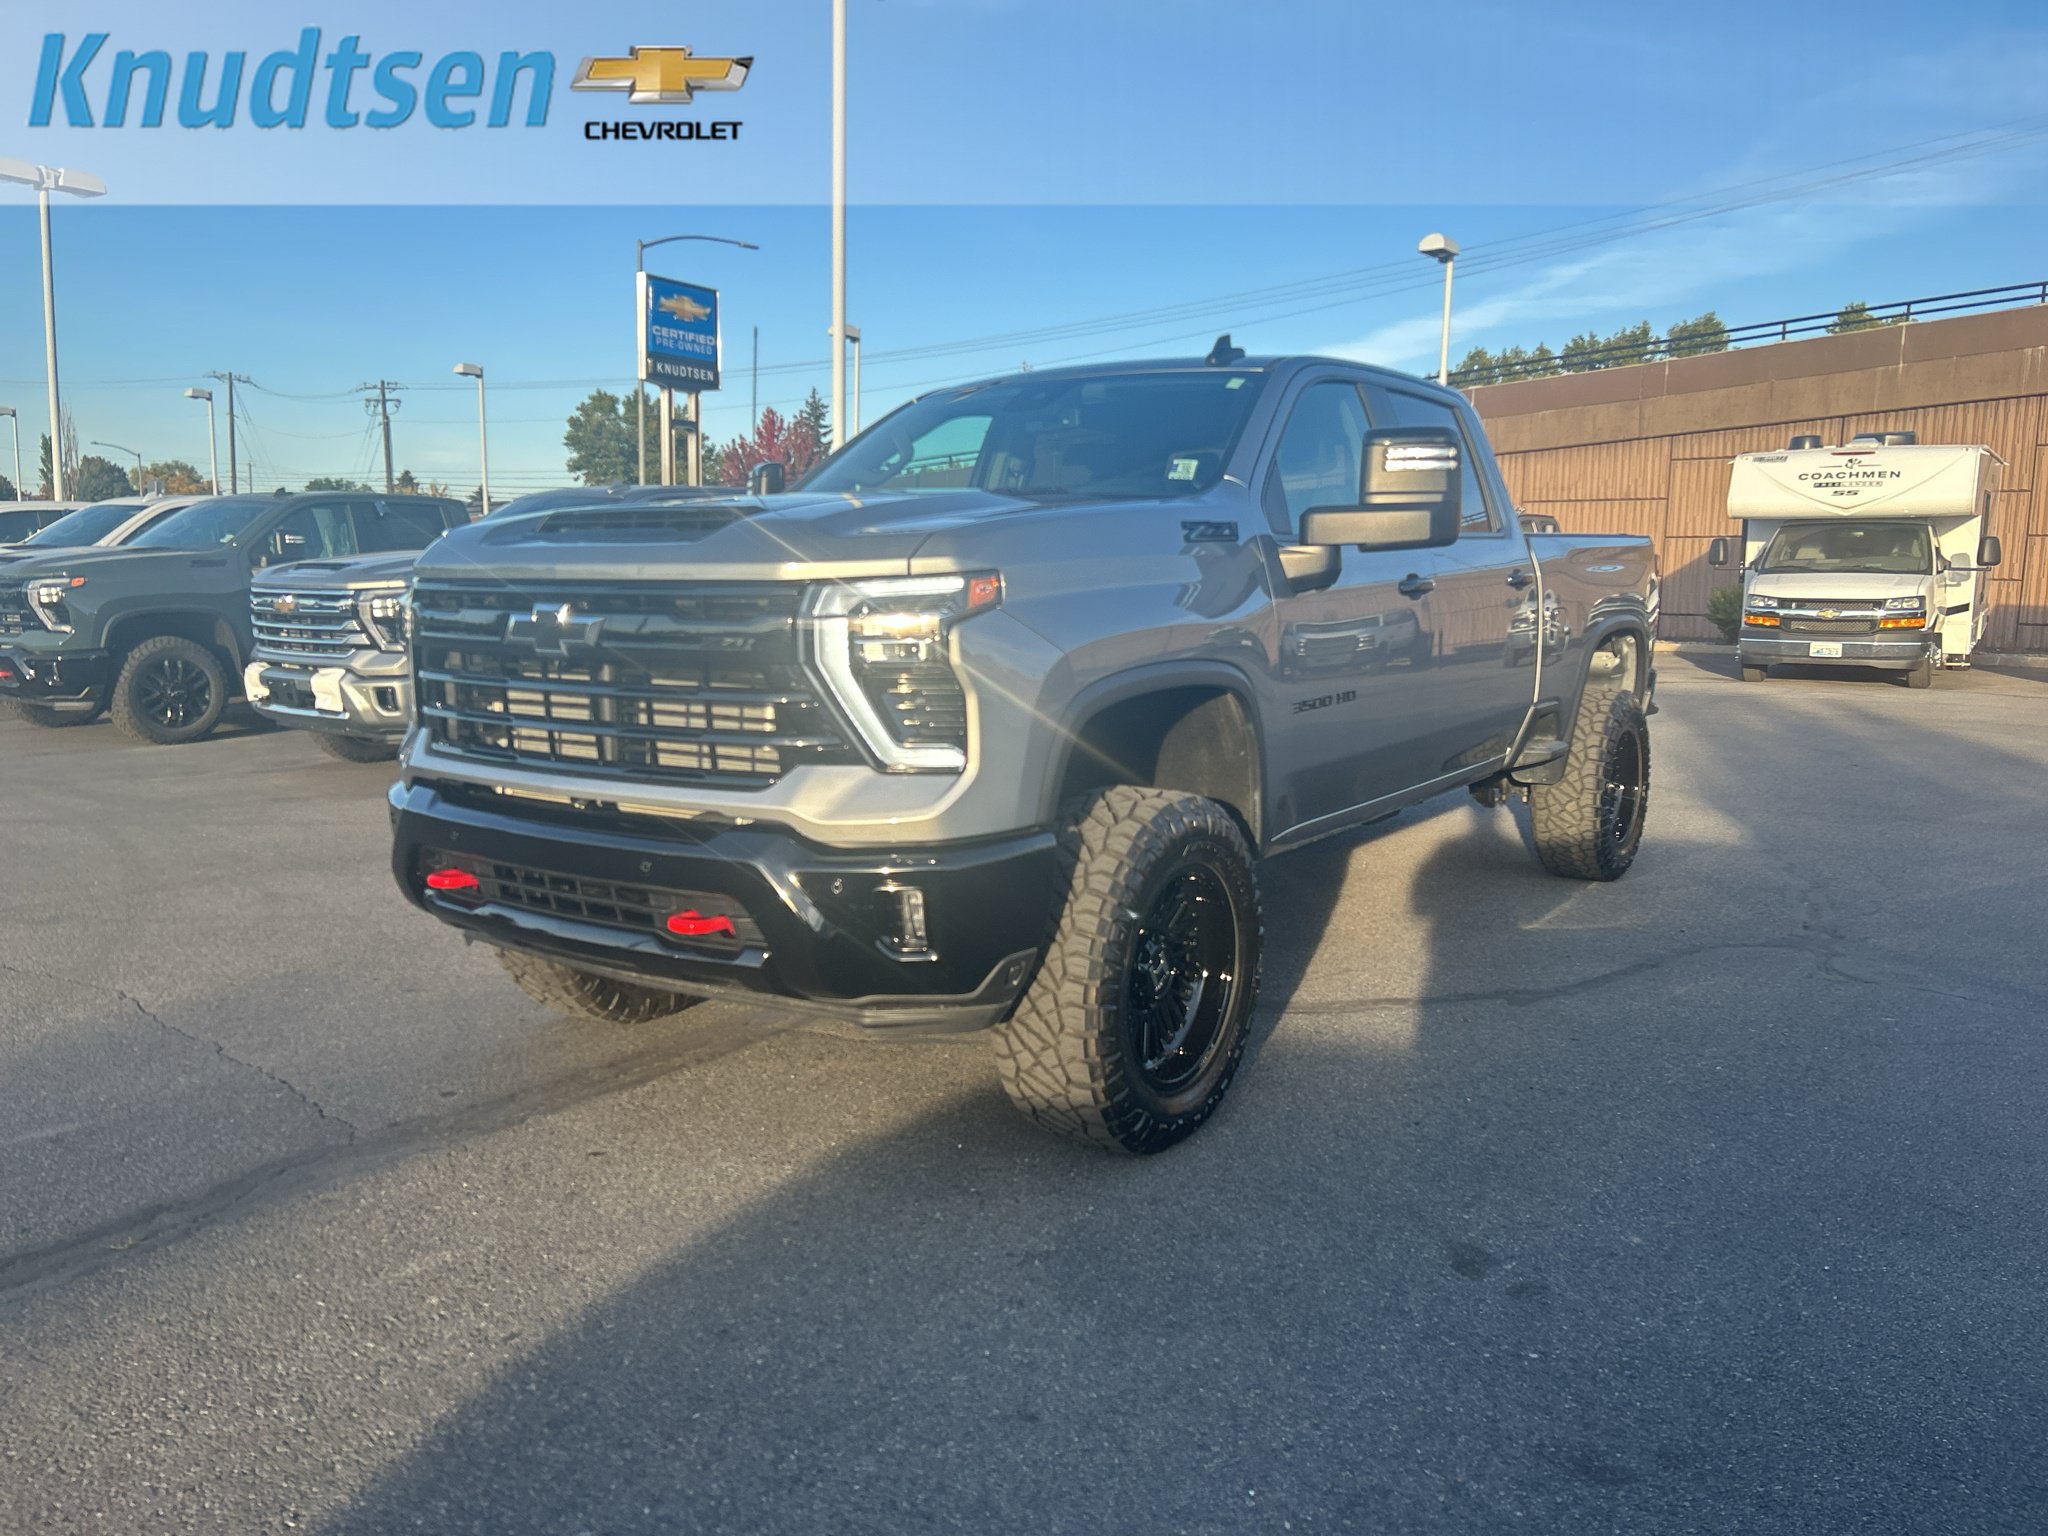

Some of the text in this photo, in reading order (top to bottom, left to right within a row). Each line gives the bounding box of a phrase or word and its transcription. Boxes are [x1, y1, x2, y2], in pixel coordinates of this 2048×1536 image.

[652, 325, 715, 346] CERTIFIED
[656, 361, 714, 381] KNUDTSEN
[1798, 470, 1901, 481] COACHMEN
[1292, 690, 1357, 715] 3500 HD
